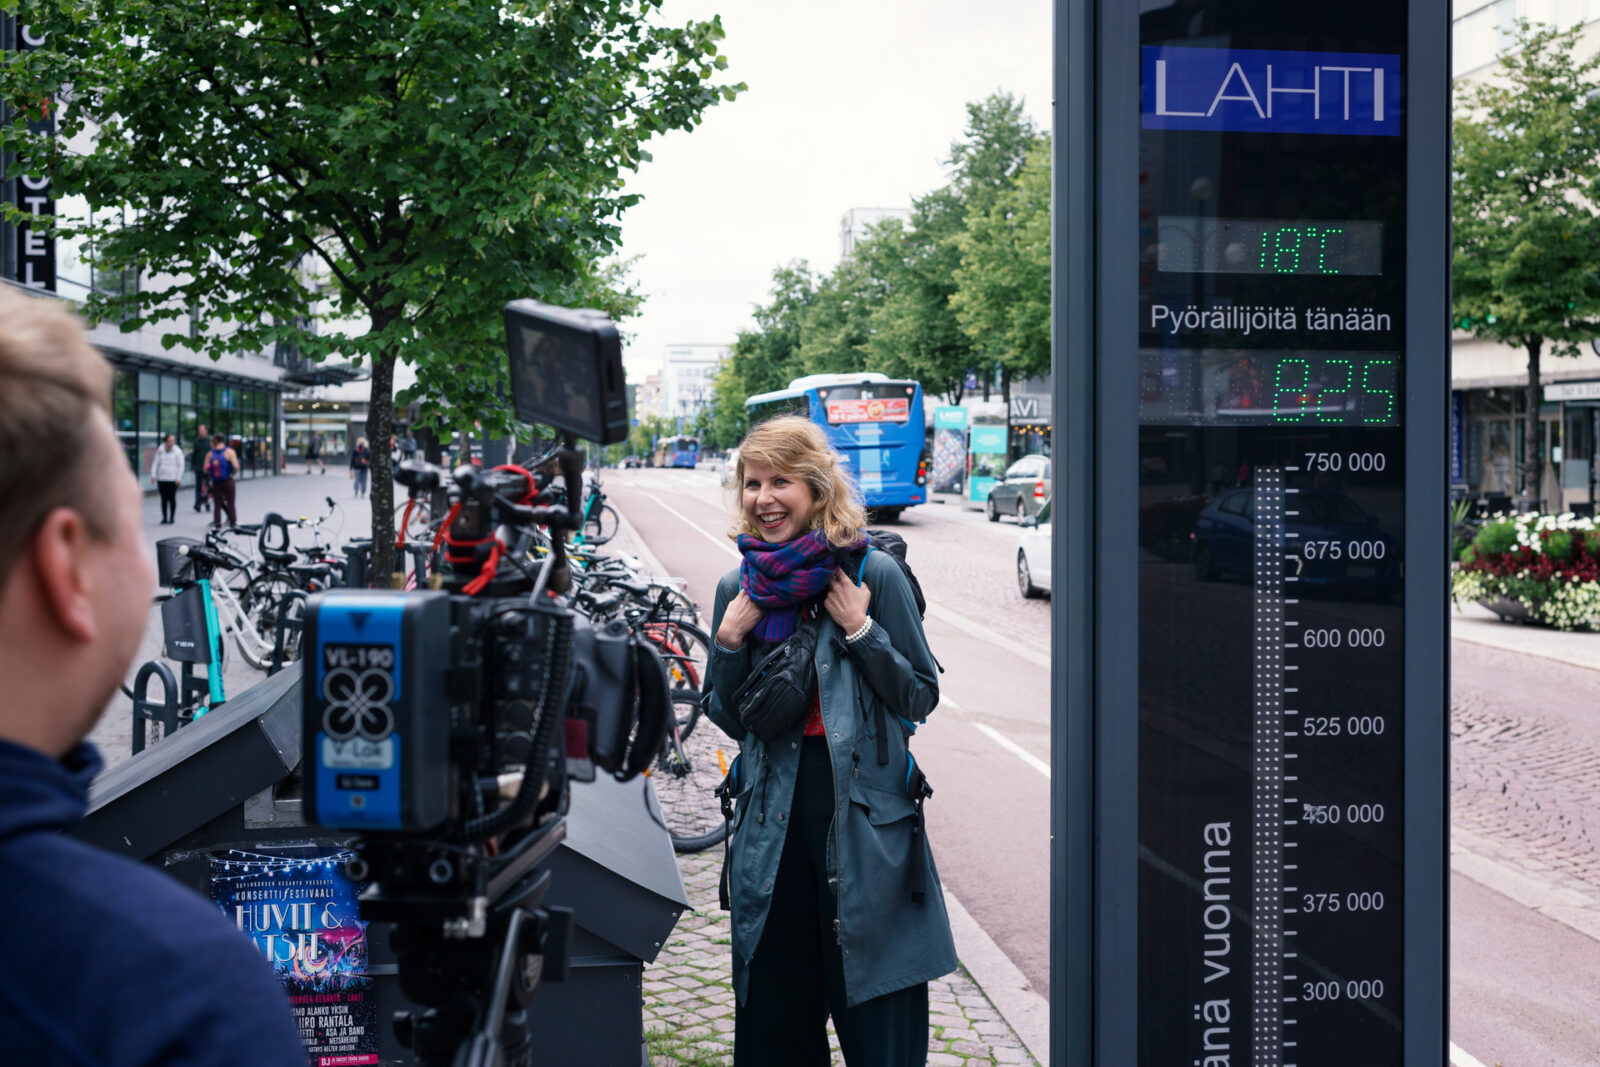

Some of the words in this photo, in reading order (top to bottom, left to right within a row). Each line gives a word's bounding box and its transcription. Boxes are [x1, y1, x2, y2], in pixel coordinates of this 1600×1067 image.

[1155, 59, 1385, 123] LAHTI
[1259, 227, 1344, 274] 18°C
[1150, 305, 1297, 335] Pyöräilijöitä
[1305, 307, 1391, 331] tänään
[1272, 358, 1394, 423] 825
[1304, 452, 1342, 472] 750
[1348, 452, 1386, 472] 000
[1304, 540, 1342, 560] 675
[1348, 540, 1386, 560] 000
[1303, 628, 1341, 648] 600
[1347, 628, 1385, 648] 000
[324, 647, 394, 669] VL-190
[1303, 717, 1341, 737] 525
[1347, 716, 1385, 736] 000
[1302, 803, 1341, 824] 450
[1347, 803, 1385, 824] 000
[1203, 821, 1232, 983] vuonna
[1303, 893, 1341, 913] 375
[1346, 891, 1384, 912] 000
[235, 903, 316, 932] HUVIT
[321, 902, 343, 930] &
[1302, 981, 1340, 1001] 300
[1346, 979, 1384, 1000] 000
[307, 1006, 329, 1016] ALANKO
[330, 1005, 349, 1014] YKSIN
[318, 1014, 354, 1028] RANTALA
[325, 1028, 338, 1037] ASA
[339, 1027, 347, 1036] JA
[348, 1026, 365, 1036] BAND
[321, 1057, 331, 1066] DJ
